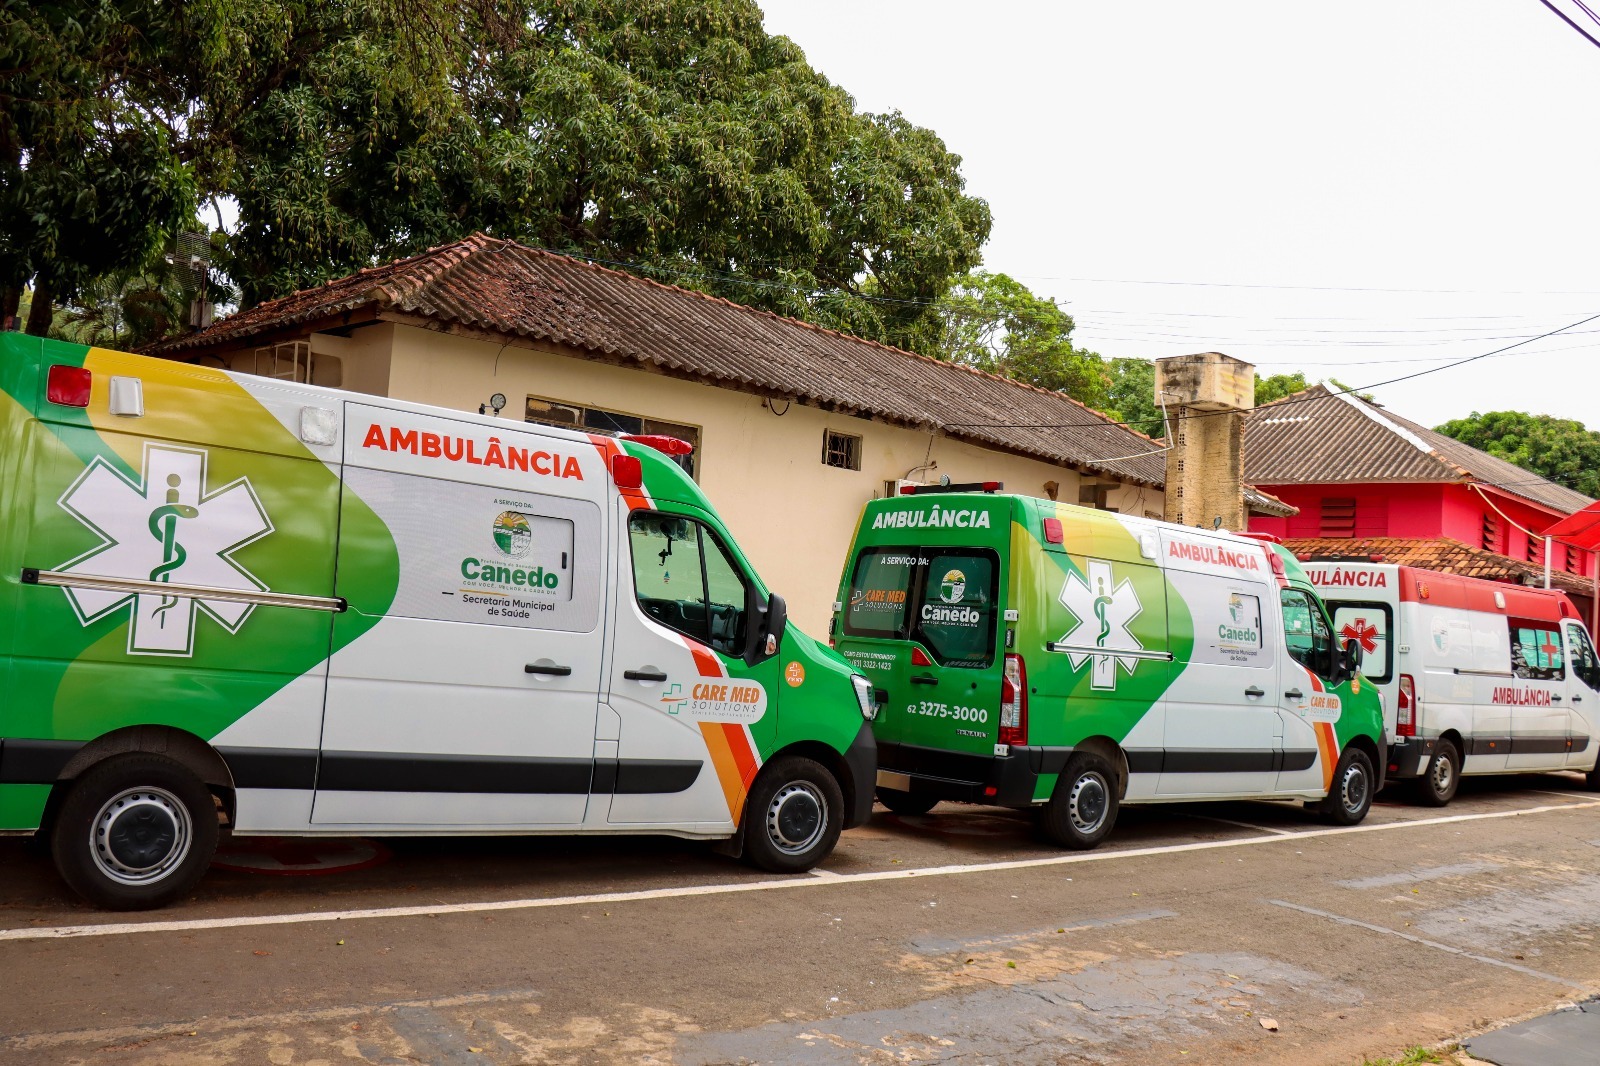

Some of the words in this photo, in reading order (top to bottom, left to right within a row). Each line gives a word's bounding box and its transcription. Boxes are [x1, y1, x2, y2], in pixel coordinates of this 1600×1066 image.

[362, 423, 584, 481] AMBULÂNCIA
[499, 499, 523, 508] SERVIÇO
[872, 504, 991, 530] AMBULÂNCIA
[880, 556, 886, 565] A
[886, 557, 917, 568] SERVIÇO
[917, 557, 930, 566] DA:
[1169, 541, 1260, 572] AMBULÂNCIA
[461, 557, 559, 590] Canedo
[1305, 567, 1387, 588] ULÂNCIA
[462, 594, 510, 607] Secretaria
[512, 599, 555, 612] Municipal
[865, 601, 904, 610] SOLUTIONS
[866, 589, 886, 602] CARE
[886, 590, 907, 603] MED
[487, 607, 500, 616] de
[501, 608, 530, 619] Saúde
[921, 604, 980, 624] Canedo
[1218, 624, 1257, 642] Canedo
[692, 683, 728, 702] CARE
[730, 686, 760, 704] MED
[1310, 696, 1325, 708] CARE
[1326, 697, 1339, 710] MED
[1491, 685, 1550, 706] AMBULÂNCIA
[907, 704, 917, 714] 62
[919, 701, 988, 723] 3275-3000
